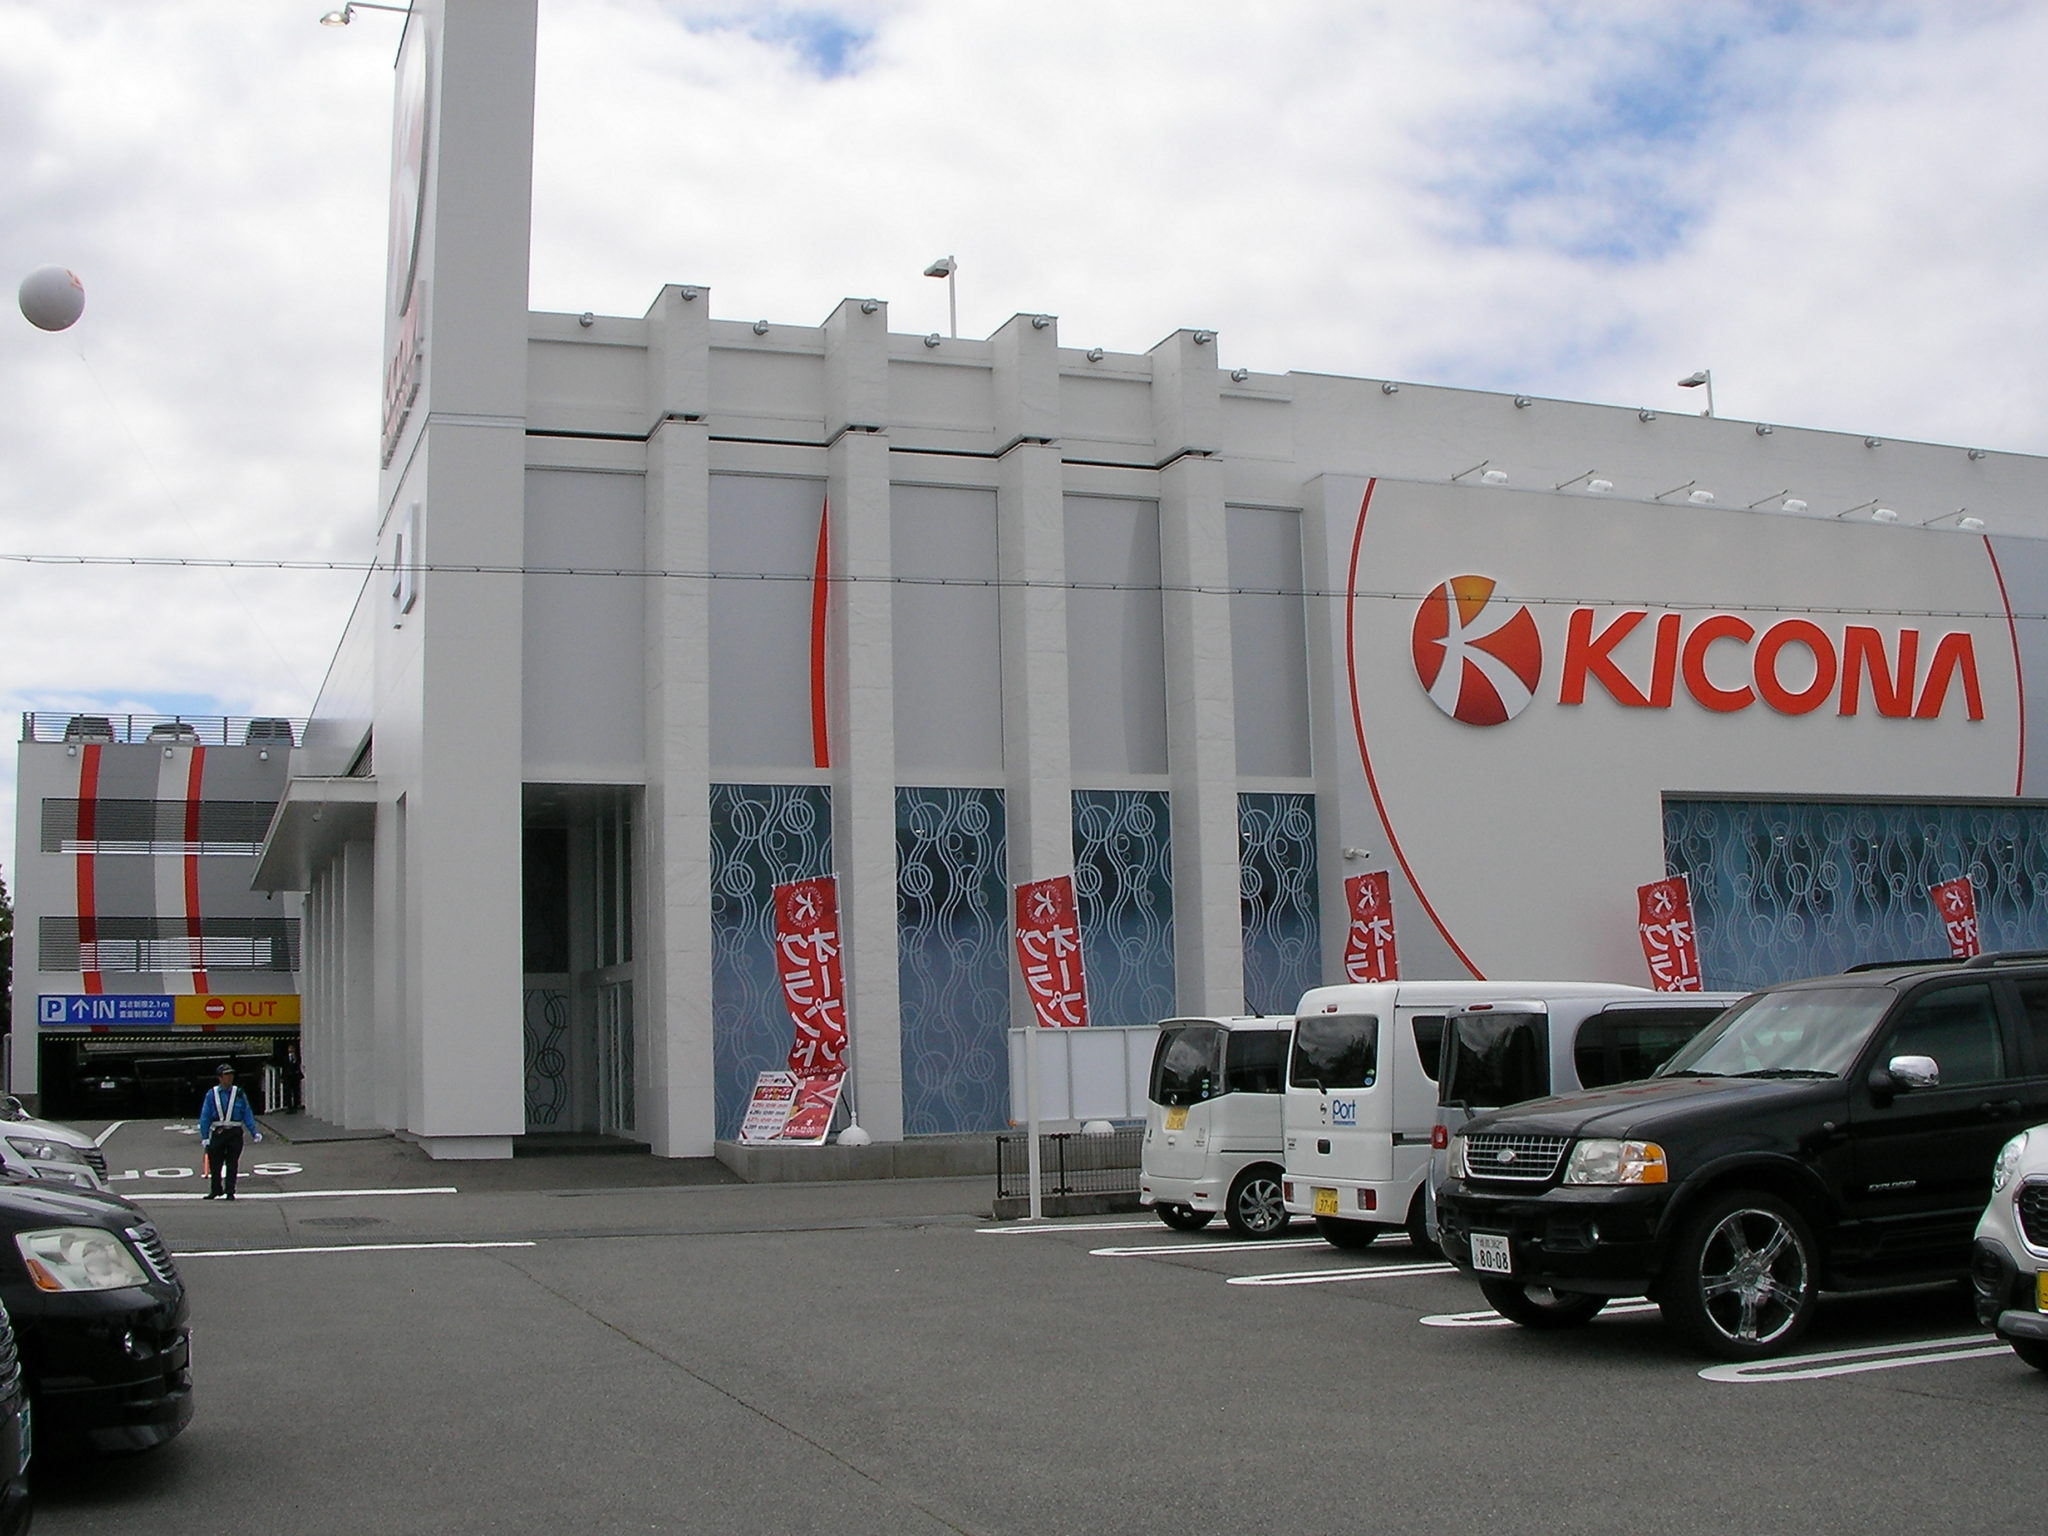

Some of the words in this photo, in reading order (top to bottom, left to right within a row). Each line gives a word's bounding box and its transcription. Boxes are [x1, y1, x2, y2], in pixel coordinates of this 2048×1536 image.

[1557, 608, 1985, 720] KICONA
[92, 1000, 115, 1019] IN
[231, 1001, 278, 1017] OUT
[1333, 1099, 1356, 1120] Port
[1480, 1250, 1508, 1269] 80-08
